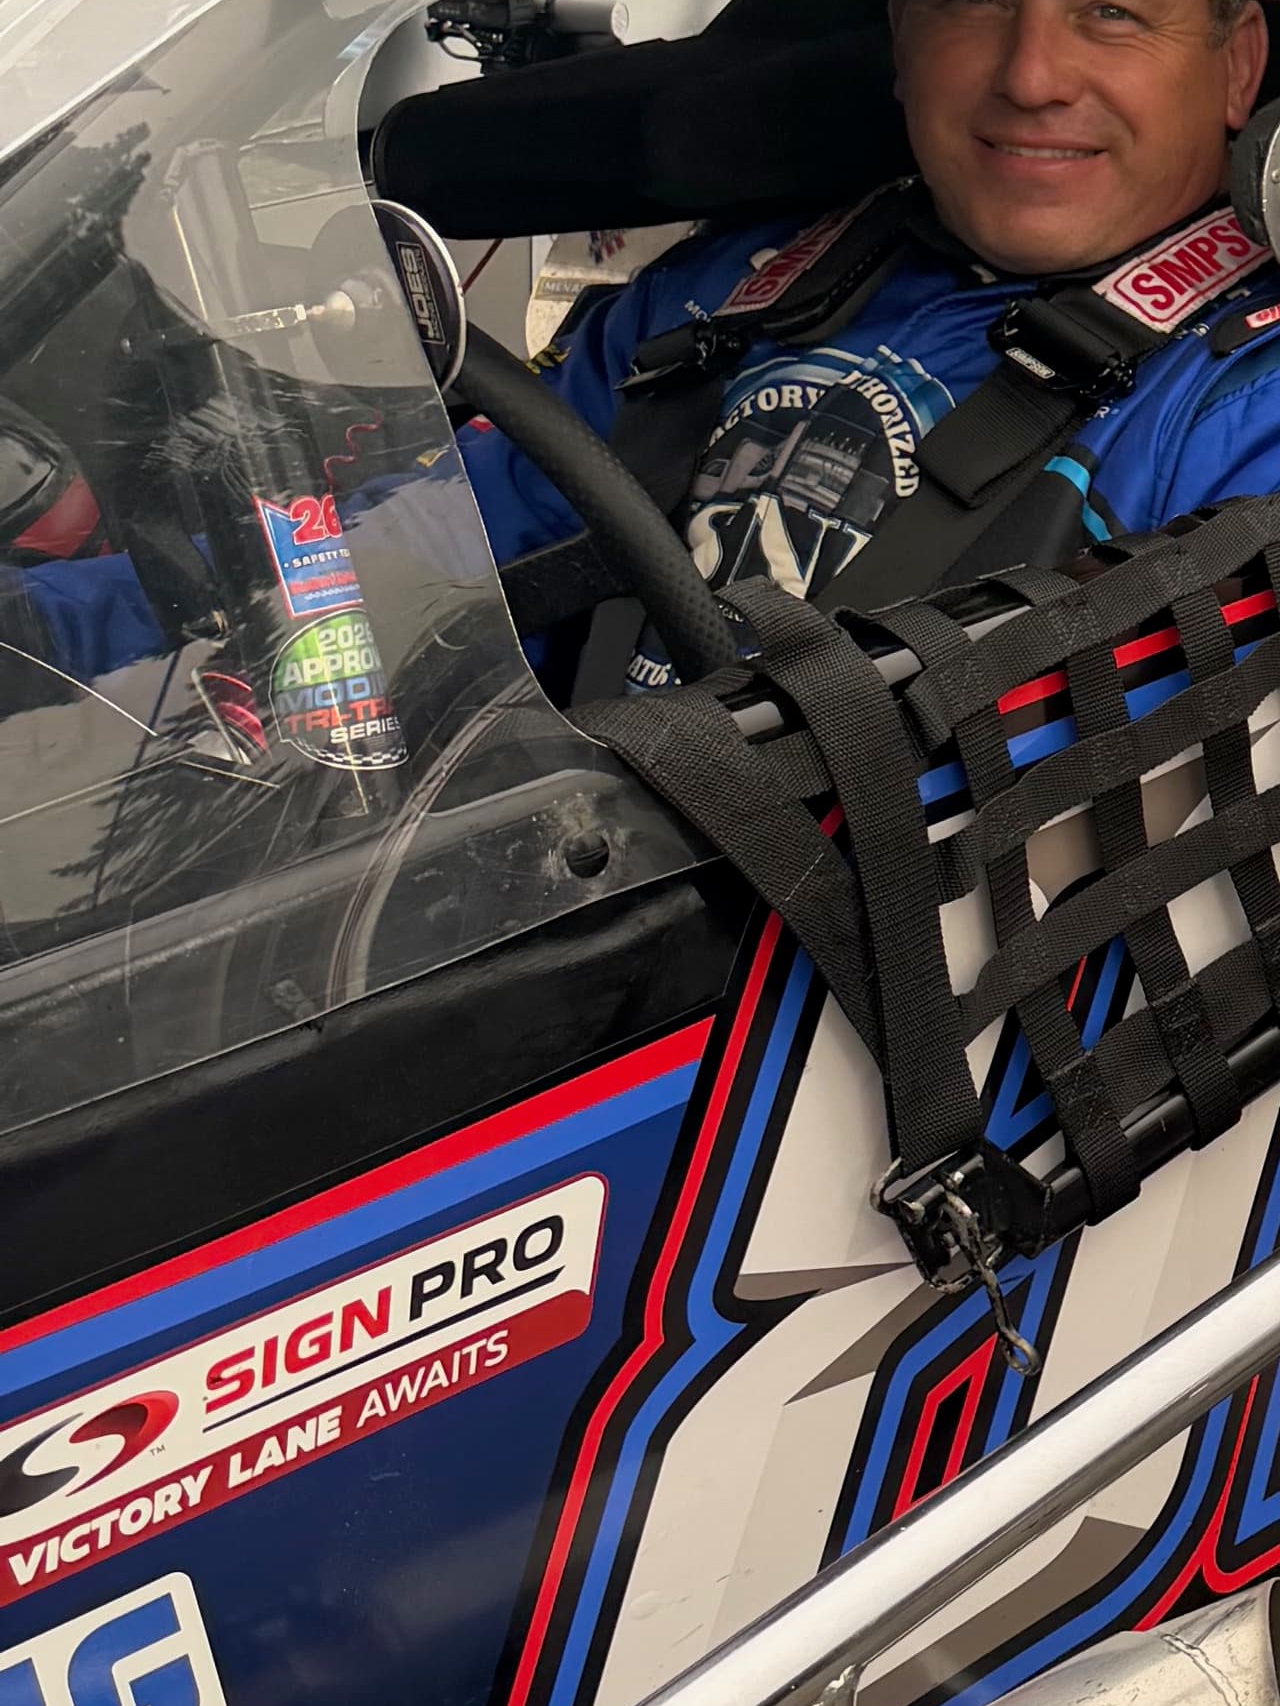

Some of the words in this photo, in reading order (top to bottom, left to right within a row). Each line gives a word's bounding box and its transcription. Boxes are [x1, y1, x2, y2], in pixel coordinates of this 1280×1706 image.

[1130, 217, 1254, 311] SIMPS
[708, 384, 827, 447] ACTORY
[204, 1284, 394, 1415] SIGN
[408, 1213, 564, 1323] PRO
[7, 1465, 214, 1588] VICTORY
[227, 1405, 343, 1489] LANE
[355, 1328, 511, 1430] AWAITS
